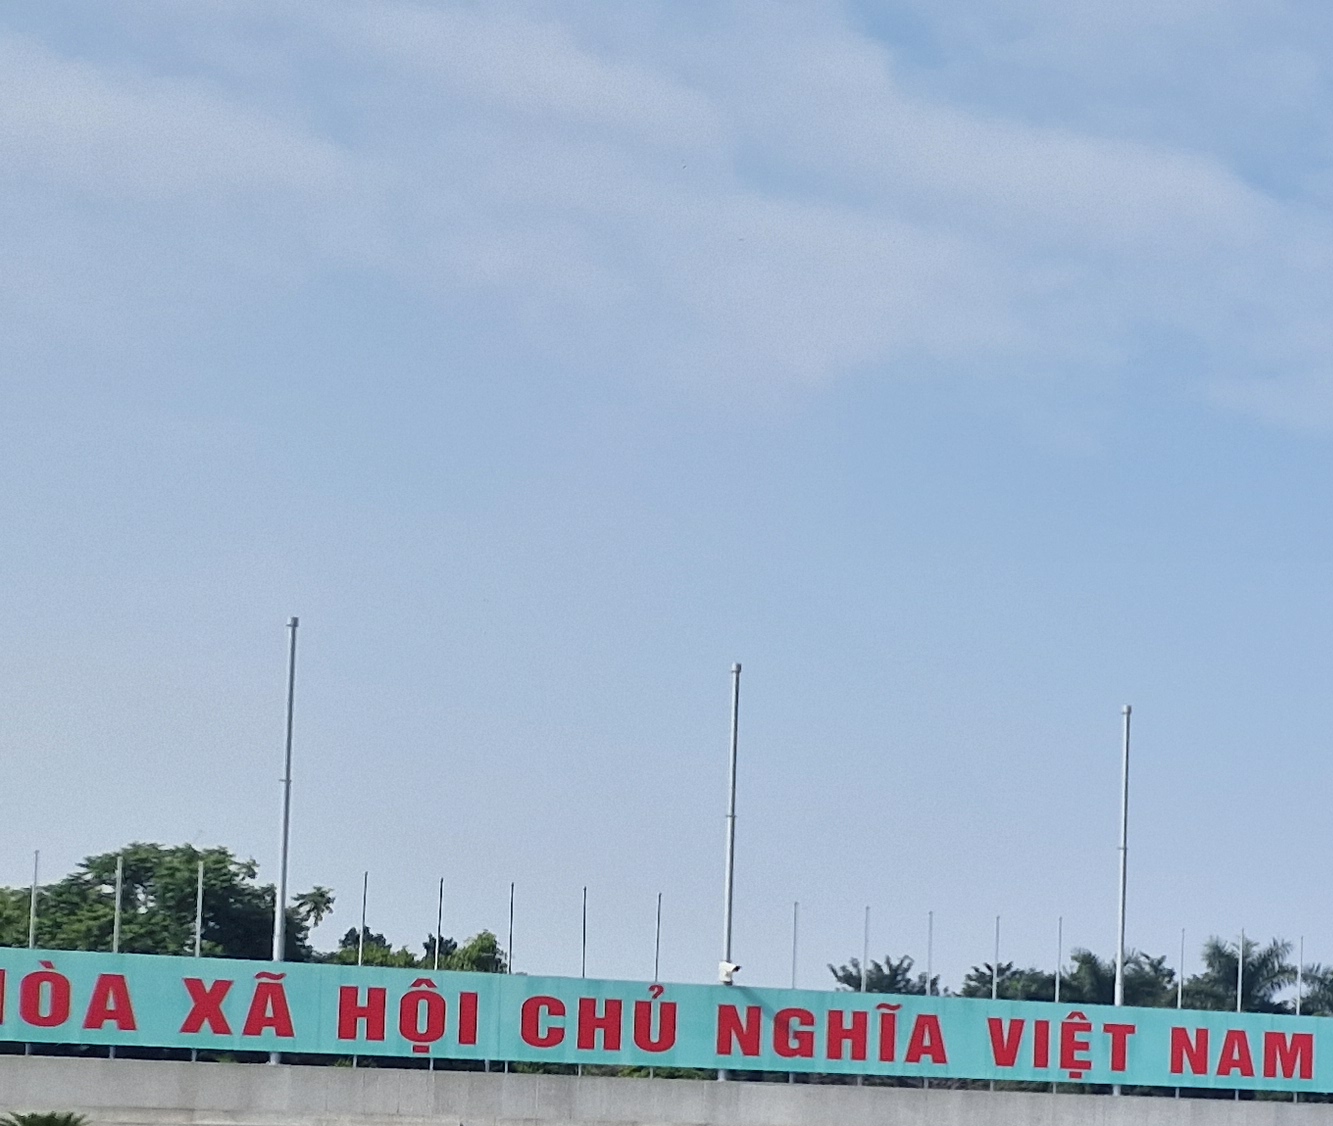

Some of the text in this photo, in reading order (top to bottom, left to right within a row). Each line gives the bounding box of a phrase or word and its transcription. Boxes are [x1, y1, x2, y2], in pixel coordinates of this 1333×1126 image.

[0, 959, 137, 1031] ÒA
[179, 971, 295, 1037] XÃ
[337, 977, 478, 1054] HỘI
[520, 984, 677, 1053] CHỦ
[716, 1002, 948, 1065] NGHĨA
[987, 1010, 1137, 1079] VIỆT
[1170, 1026, 1315, 1080] NAM
